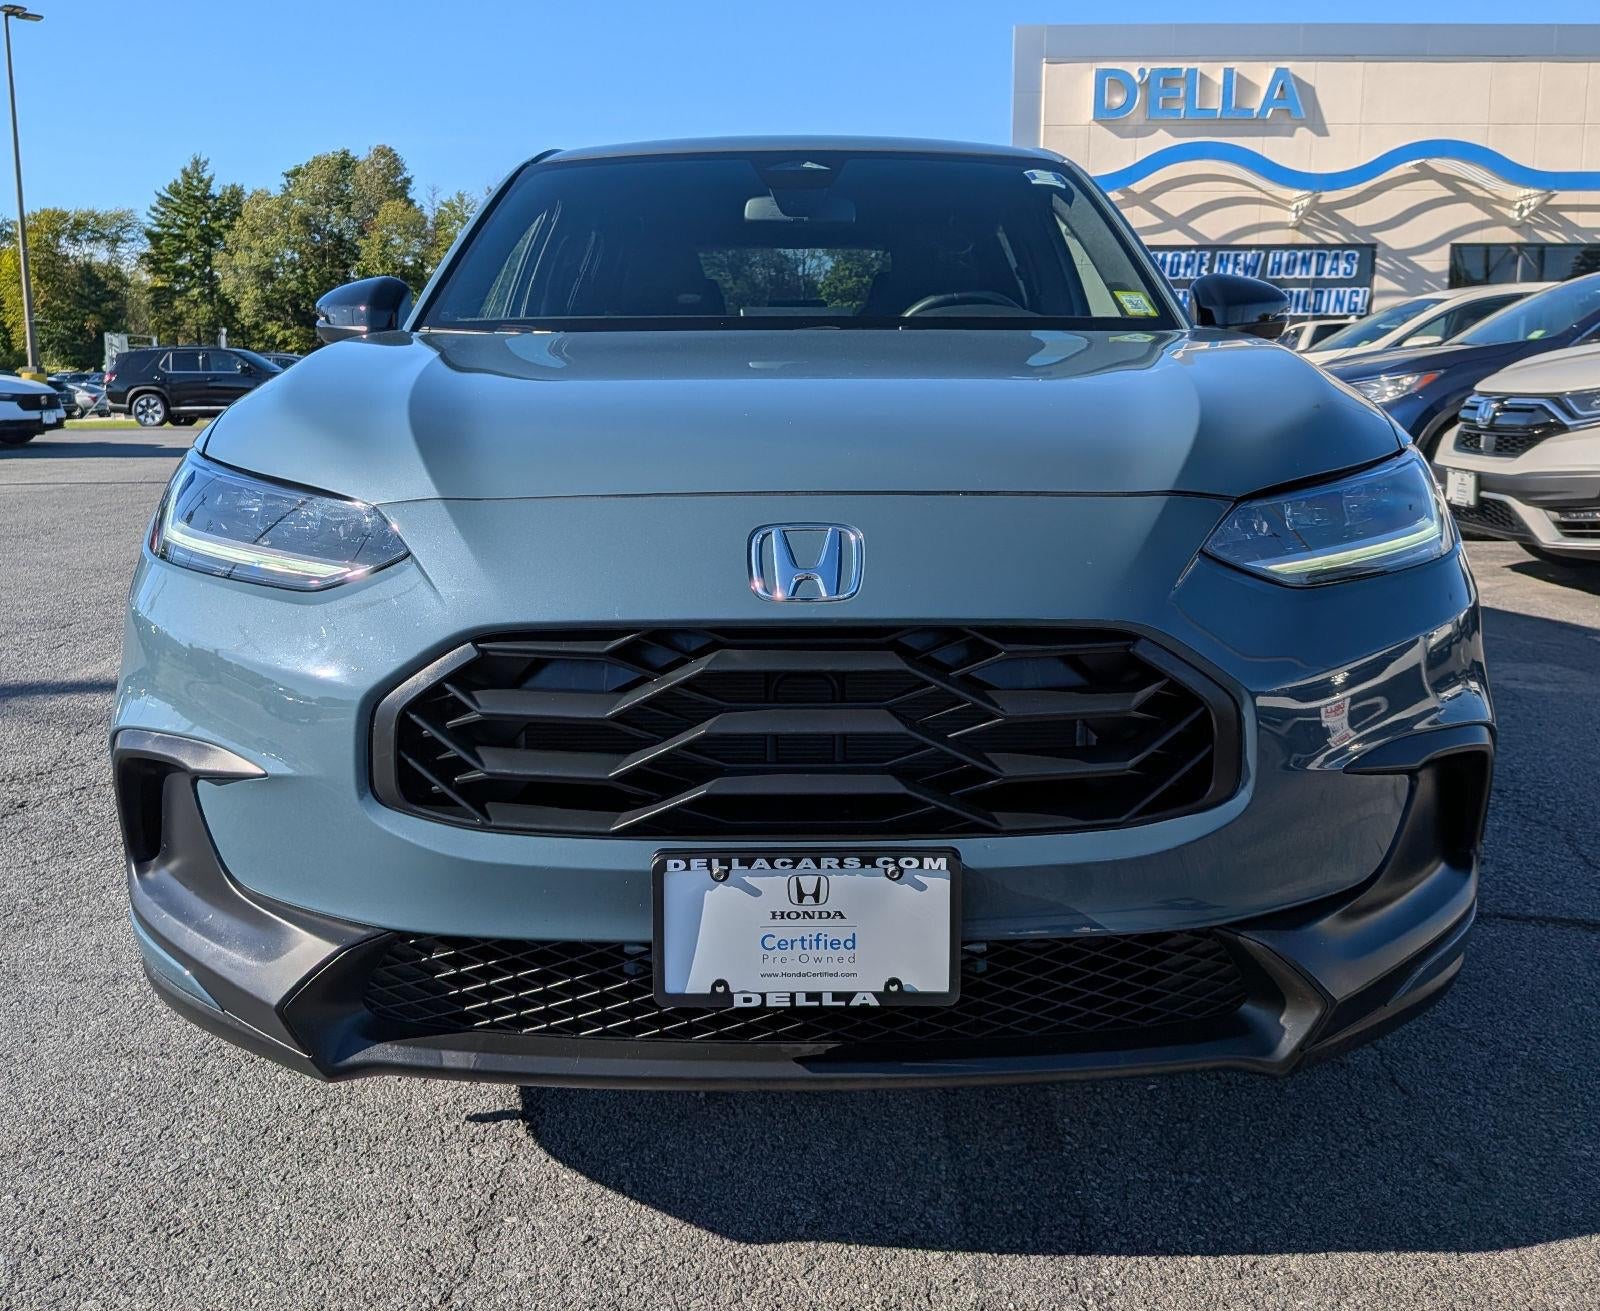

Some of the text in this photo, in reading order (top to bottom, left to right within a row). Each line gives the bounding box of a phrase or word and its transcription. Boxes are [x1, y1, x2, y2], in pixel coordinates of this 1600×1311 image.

[1092, 66, 1306, 121] D'ELLA
[1213, 250, 1265, 278] NEW
[1266, 249, 1361, 279] HONDAS
[1280, 287, 1370, 316] ILDING!
[666, 857, 948, 872] DELLACARS.COM
[769, 910, 847, 920] HONDA
[760, 932, 856, 951] Certified
[762, 953, 856, 964] Pre-Owned
[759, 971, 858, 979] www.HondaCertified.com
[733, 992, 880, 1007] DELLA
